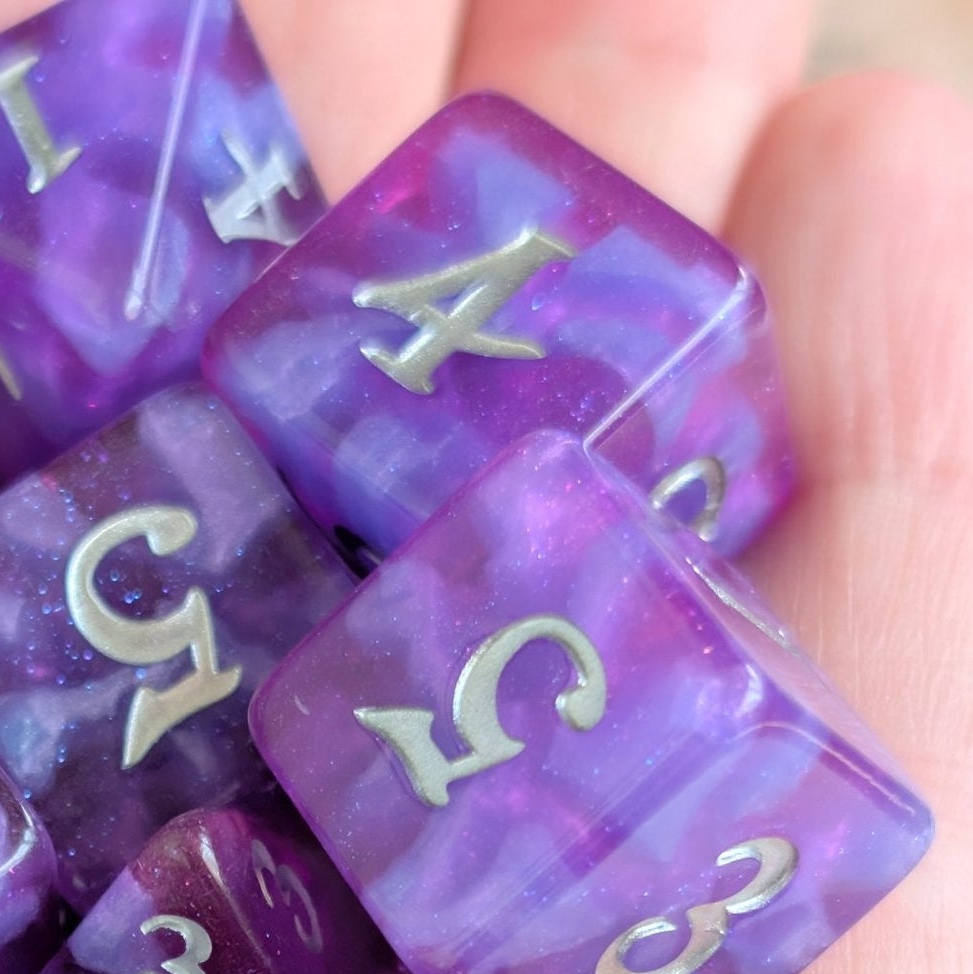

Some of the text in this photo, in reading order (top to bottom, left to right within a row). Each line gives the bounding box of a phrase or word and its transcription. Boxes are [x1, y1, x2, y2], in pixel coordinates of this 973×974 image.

[203, 127, 302, 247] 4
[352, 226, 574, 395] 4
[65, 505, 241, 770] 5
[354, 614, 607, 806] 5
[252, 838, 323, 953] 3
